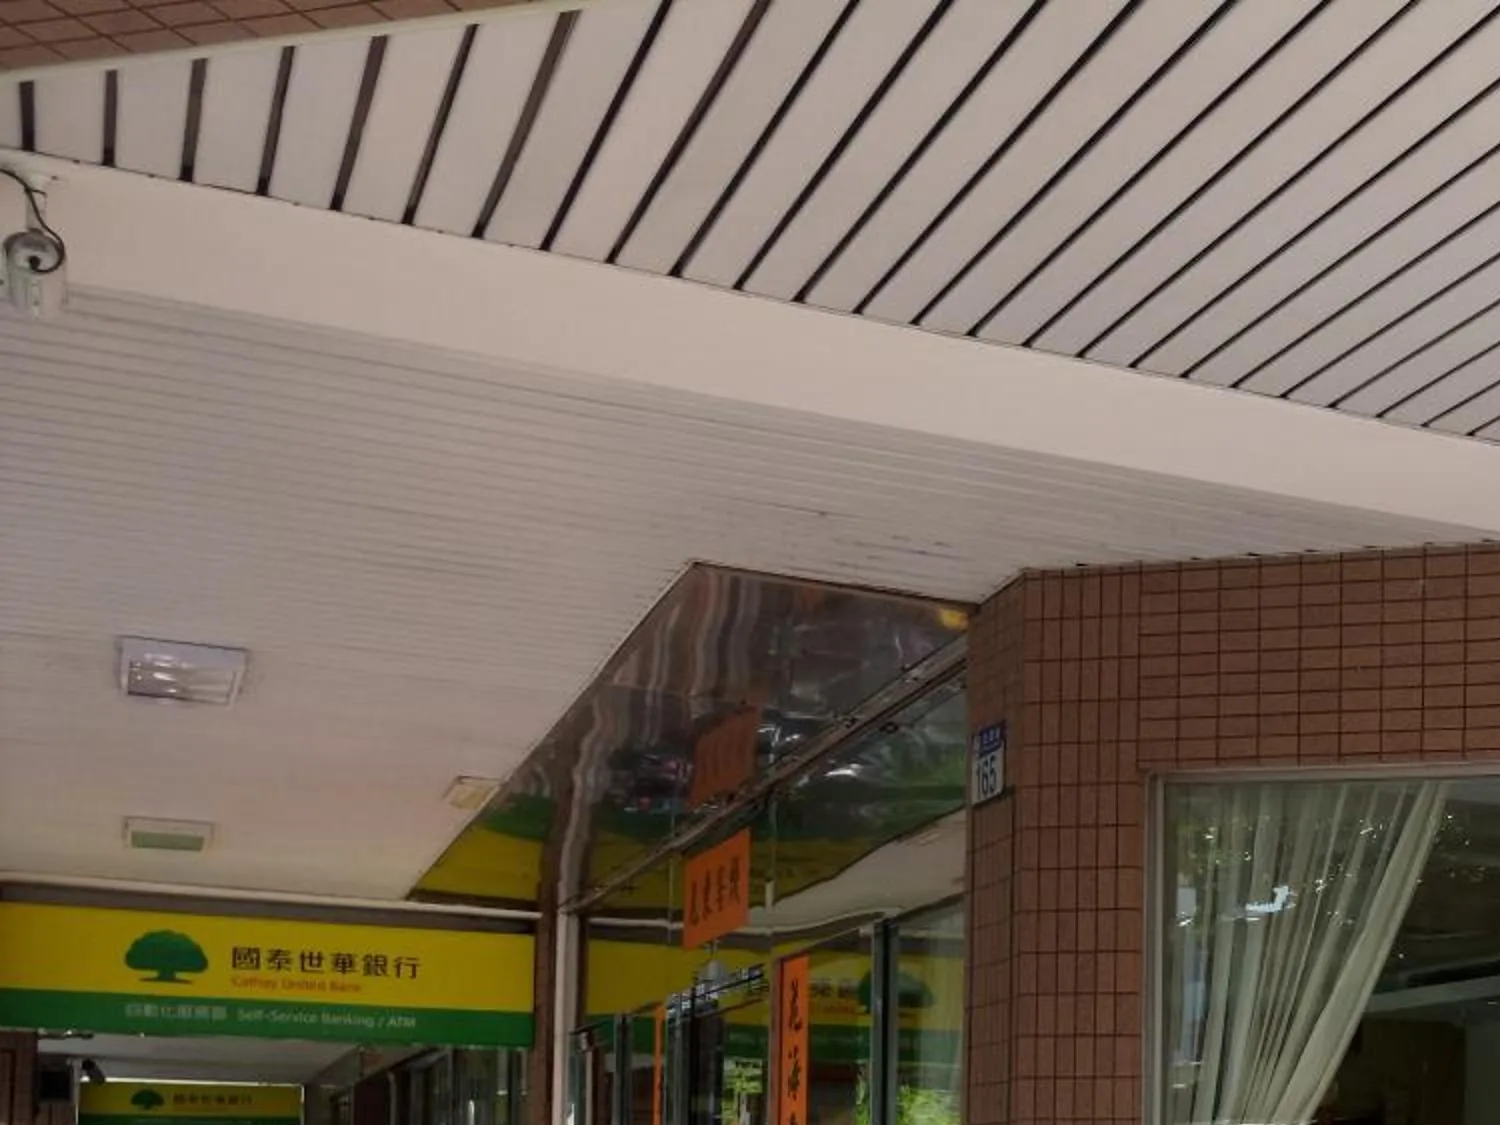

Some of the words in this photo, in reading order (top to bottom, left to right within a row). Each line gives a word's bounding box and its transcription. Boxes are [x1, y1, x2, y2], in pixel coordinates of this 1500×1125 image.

[975, 754, 997, 799] 165
[231, 946, 421, 978] 國泰世華銀行
[237, 1008, 318, 1024] Self-Service
[321, 1012, 375, 1028] Banking
[387, 1017, 416, 1028] ATM
